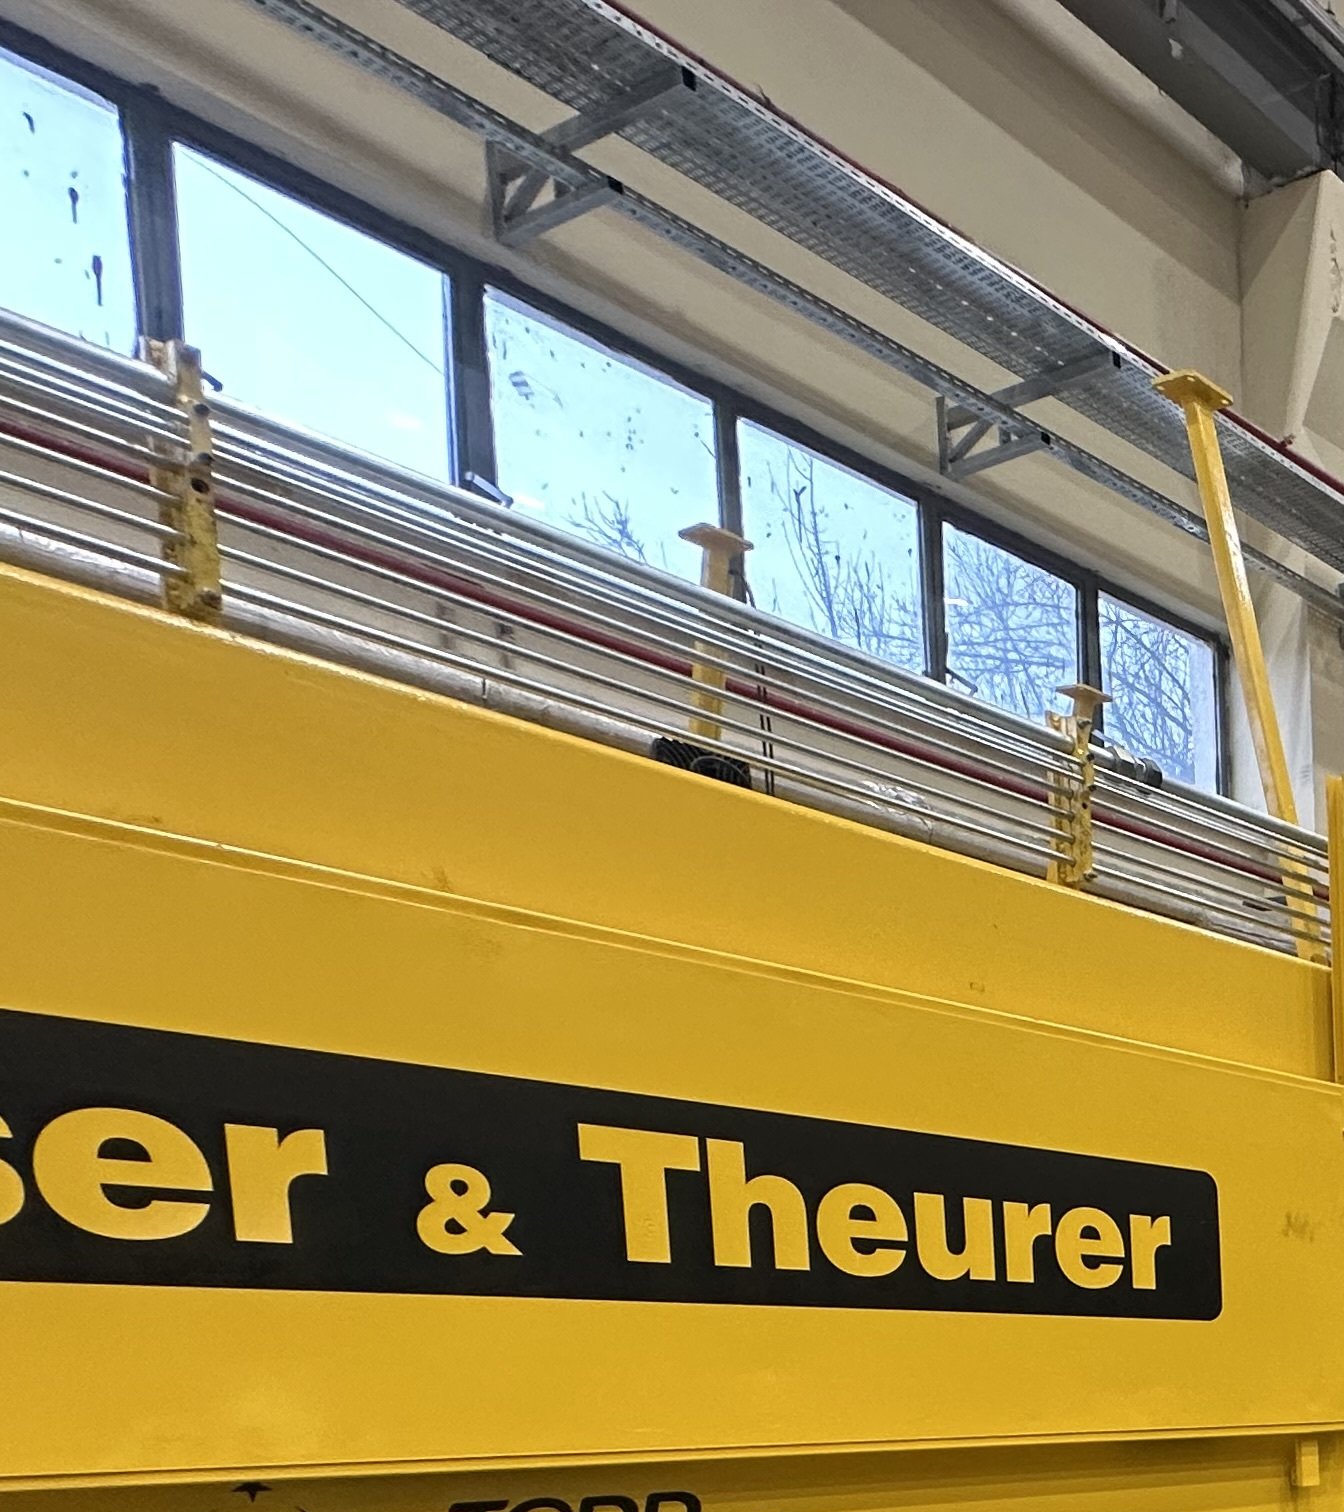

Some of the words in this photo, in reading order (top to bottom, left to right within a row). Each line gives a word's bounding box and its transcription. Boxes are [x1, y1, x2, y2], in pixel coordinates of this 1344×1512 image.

[0, 1107, 328, 1244] er
[416, 1162, 523, 1256] &
[577, 1122, 1172, 1291] Theurer
